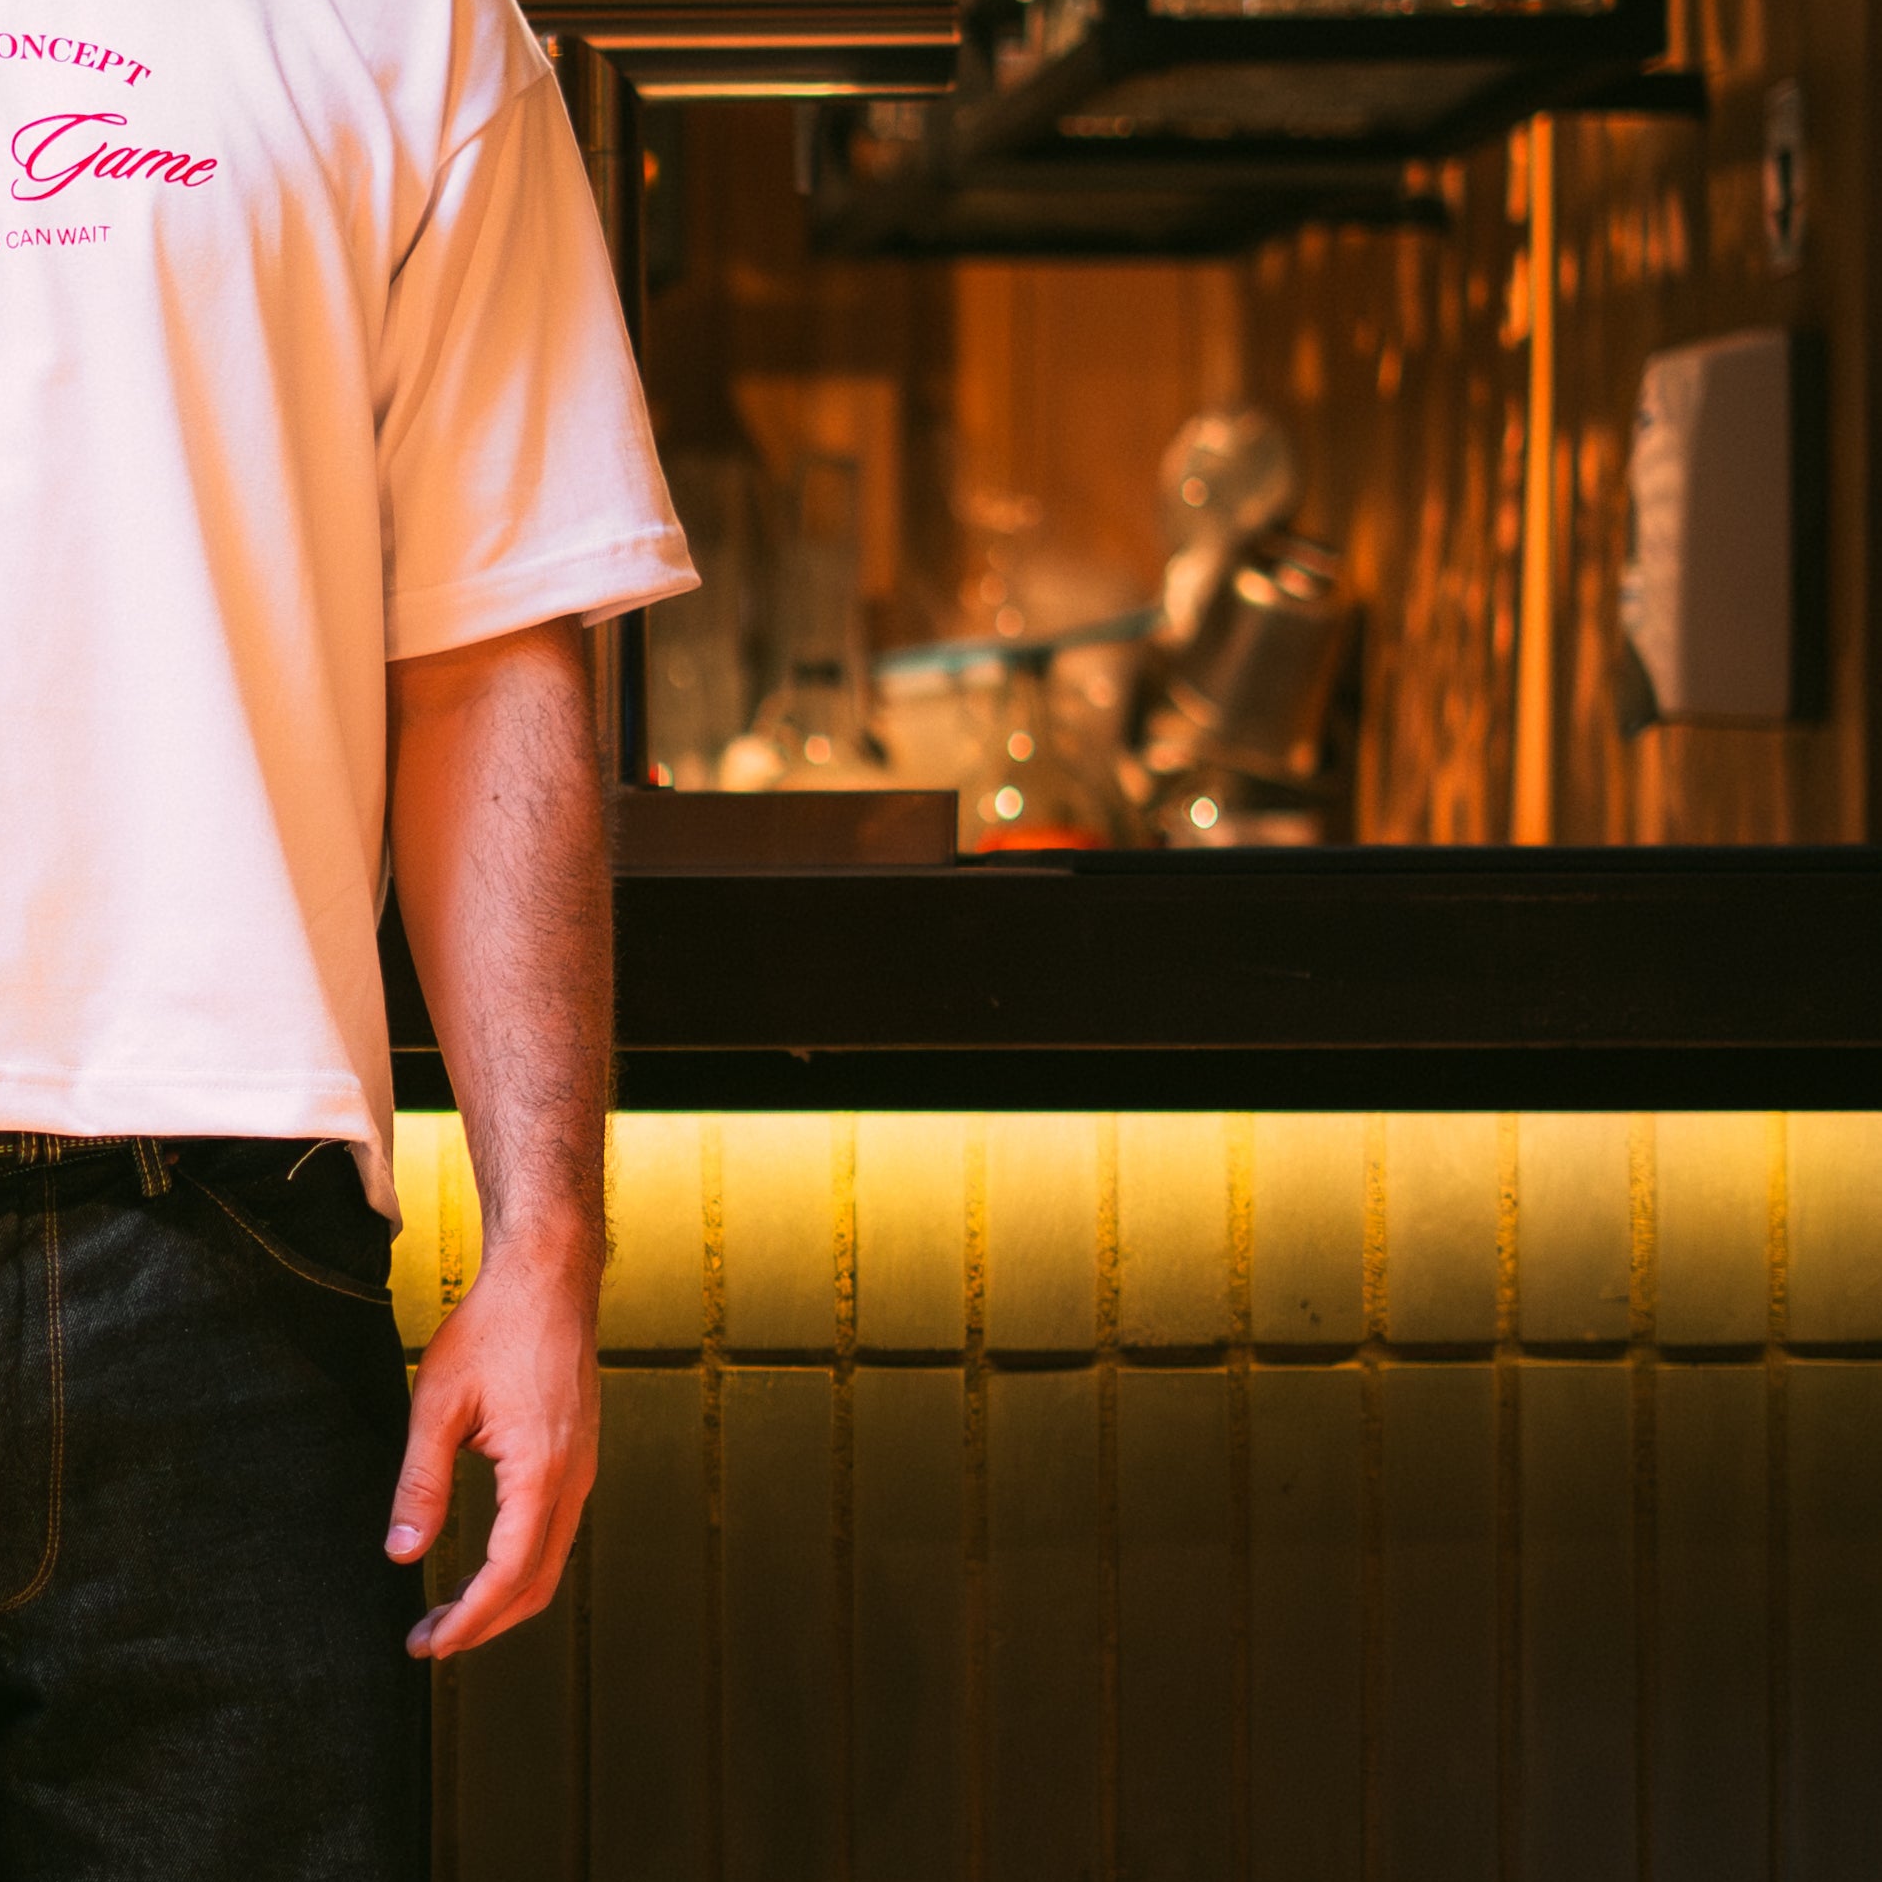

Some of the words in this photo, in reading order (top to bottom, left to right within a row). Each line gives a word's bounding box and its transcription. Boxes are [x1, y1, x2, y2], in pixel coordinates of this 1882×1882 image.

[11, 112, 219, 202] Game
[5, 227, 52, 250] CAN
[56, 224, 112, 246] WAIT
